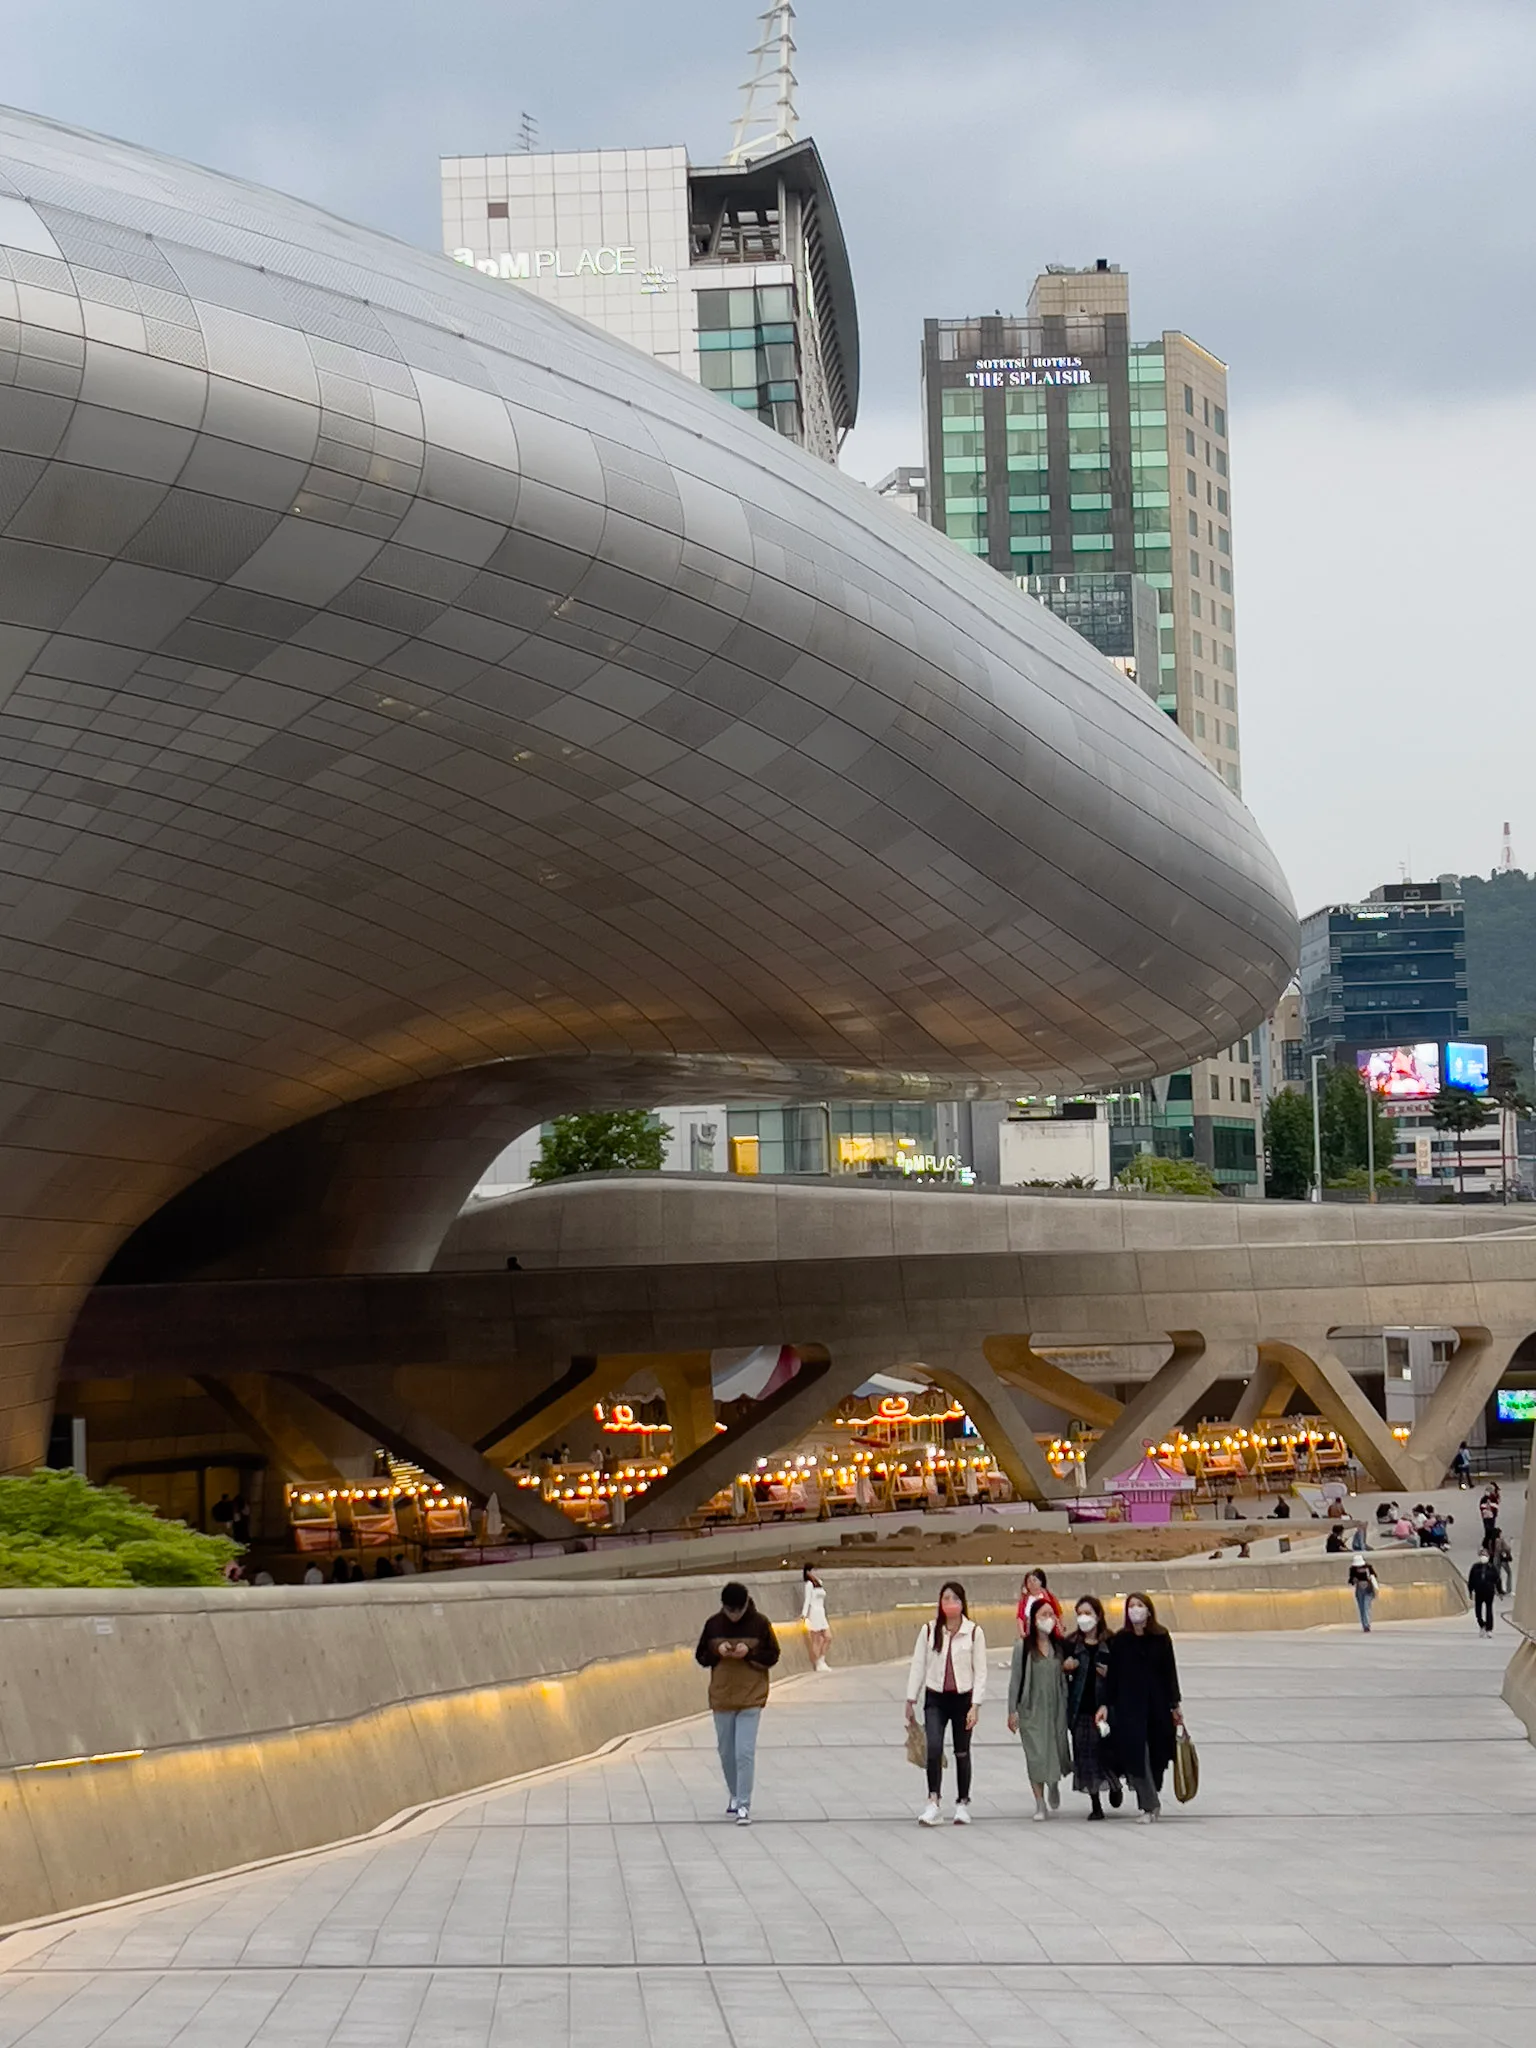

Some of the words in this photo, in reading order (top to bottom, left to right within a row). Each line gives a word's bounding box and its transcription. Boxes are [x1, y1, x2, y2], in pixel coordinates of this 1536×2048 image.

[534, 245, 636, 278] PLACE
[976, 358, 1028, 369] SOTETSU
[1032, 356, 1082, 368] HOTELS
[966, 372, 1004, 387] THE
[1009, 369, 1092, 387] SPLAISIR
